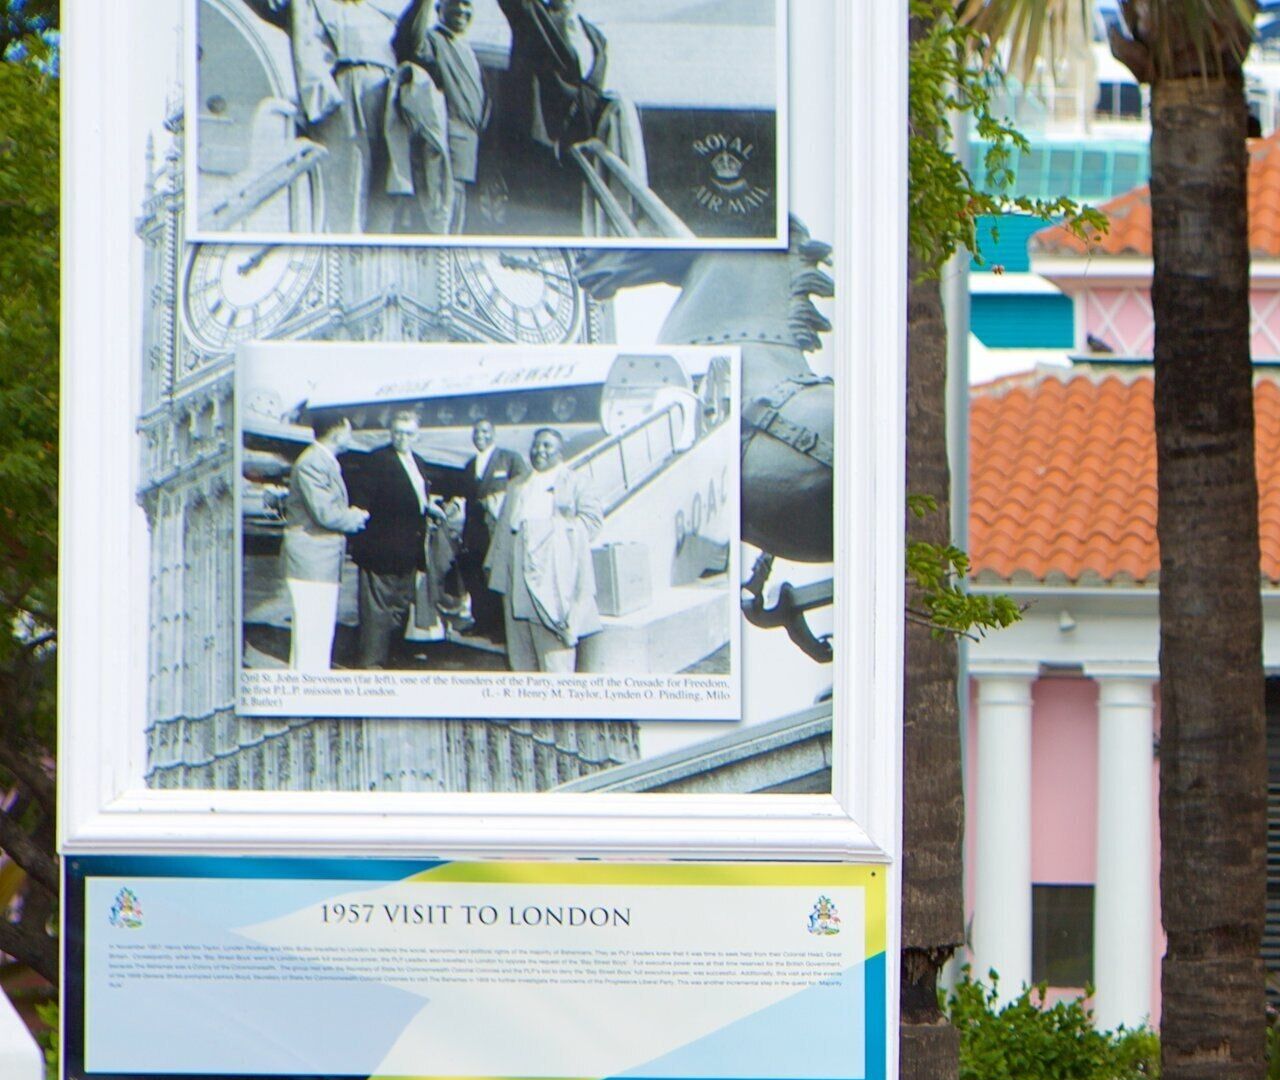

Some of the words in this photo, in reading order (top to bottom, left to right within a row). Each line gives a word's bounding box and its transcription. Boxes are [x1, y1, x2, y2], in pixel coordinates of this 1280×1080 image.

[692, 133, 753, 160] ROYAL
[302, 673, 352, 685] Stevenson
[420, 676, 431, 686] of
[433, 676, 447, 686] the
[451, 676, 493, 687] founders
[496, 676, 506, 687] of
[509, 677, 524, 687] the
[607, 678, 621, 688] the
[624, 678, 665, 689] Crusade
[667, 678, 681, 689] for
[518, 688, 547, 701] Henry
[605, 688, 641, 702] Lynden
[706, 690, 731, 701] Milo
[321, 903, 375, 924] 1957
[383, 904, 452, 925] VISIT
[461, 905, 499, 926] TO
[509, 905, 631, 927] LONDON
